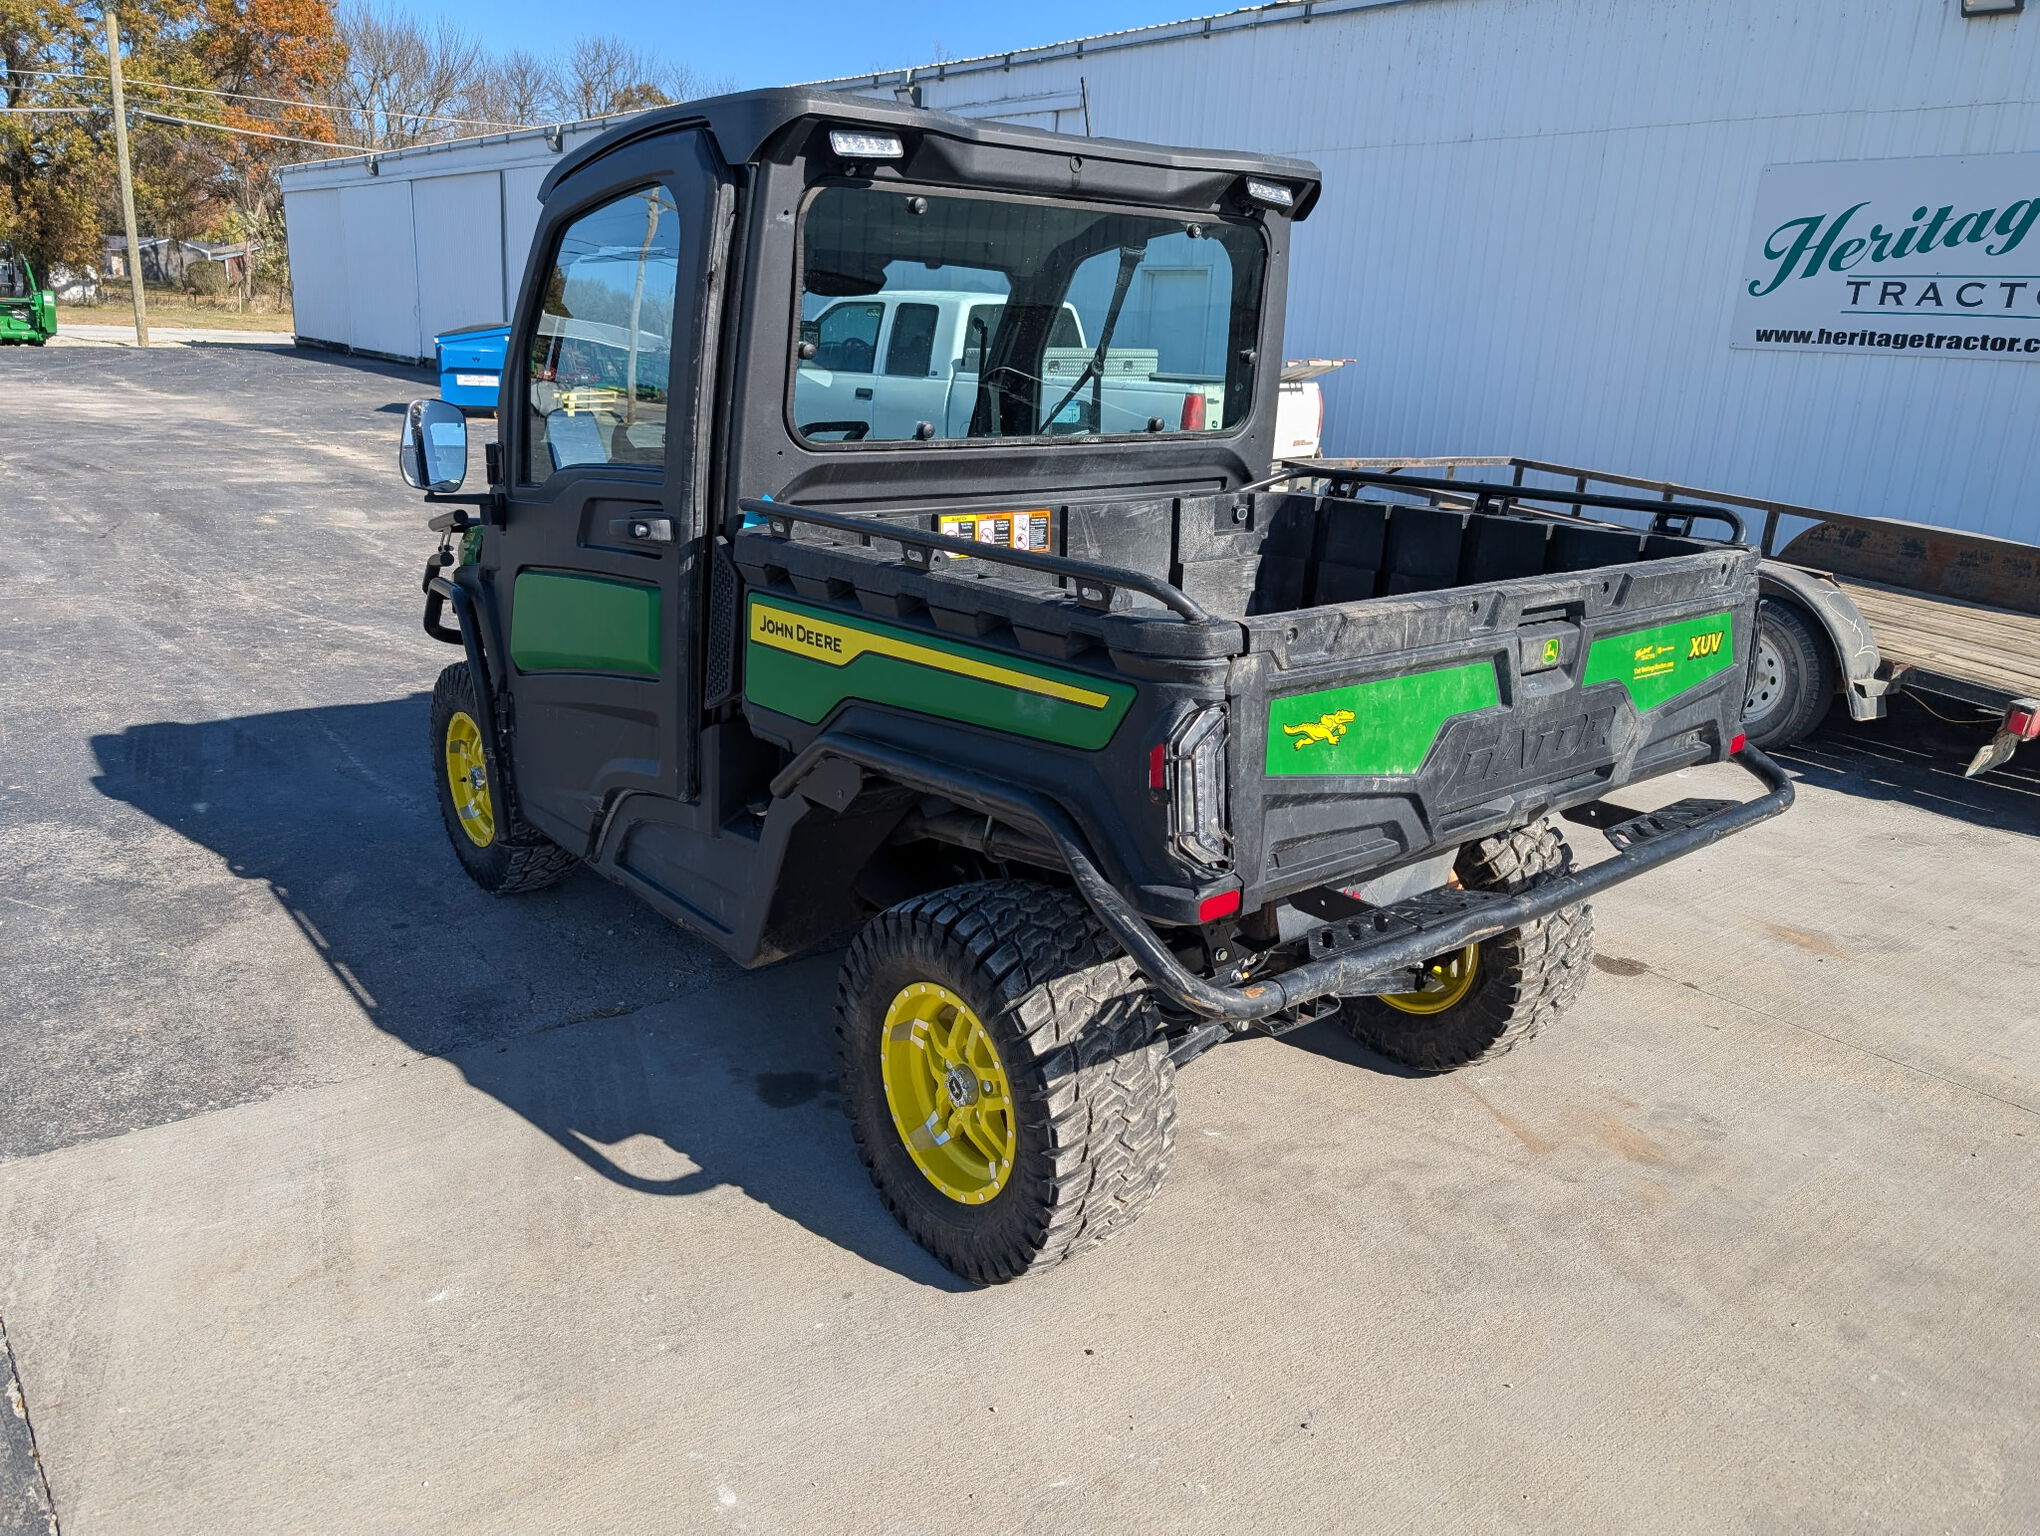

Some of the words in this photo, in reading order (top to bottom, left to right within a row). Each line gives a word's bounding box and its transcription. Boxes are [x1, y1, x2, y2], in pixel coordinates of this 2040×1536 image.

[1846, 280, 2040, 308] TRACT
[759, 614, 794, 641] JOHN
[796, 624, 843, 653] DEERE
[1687, 631, 1724, 660] XUV
